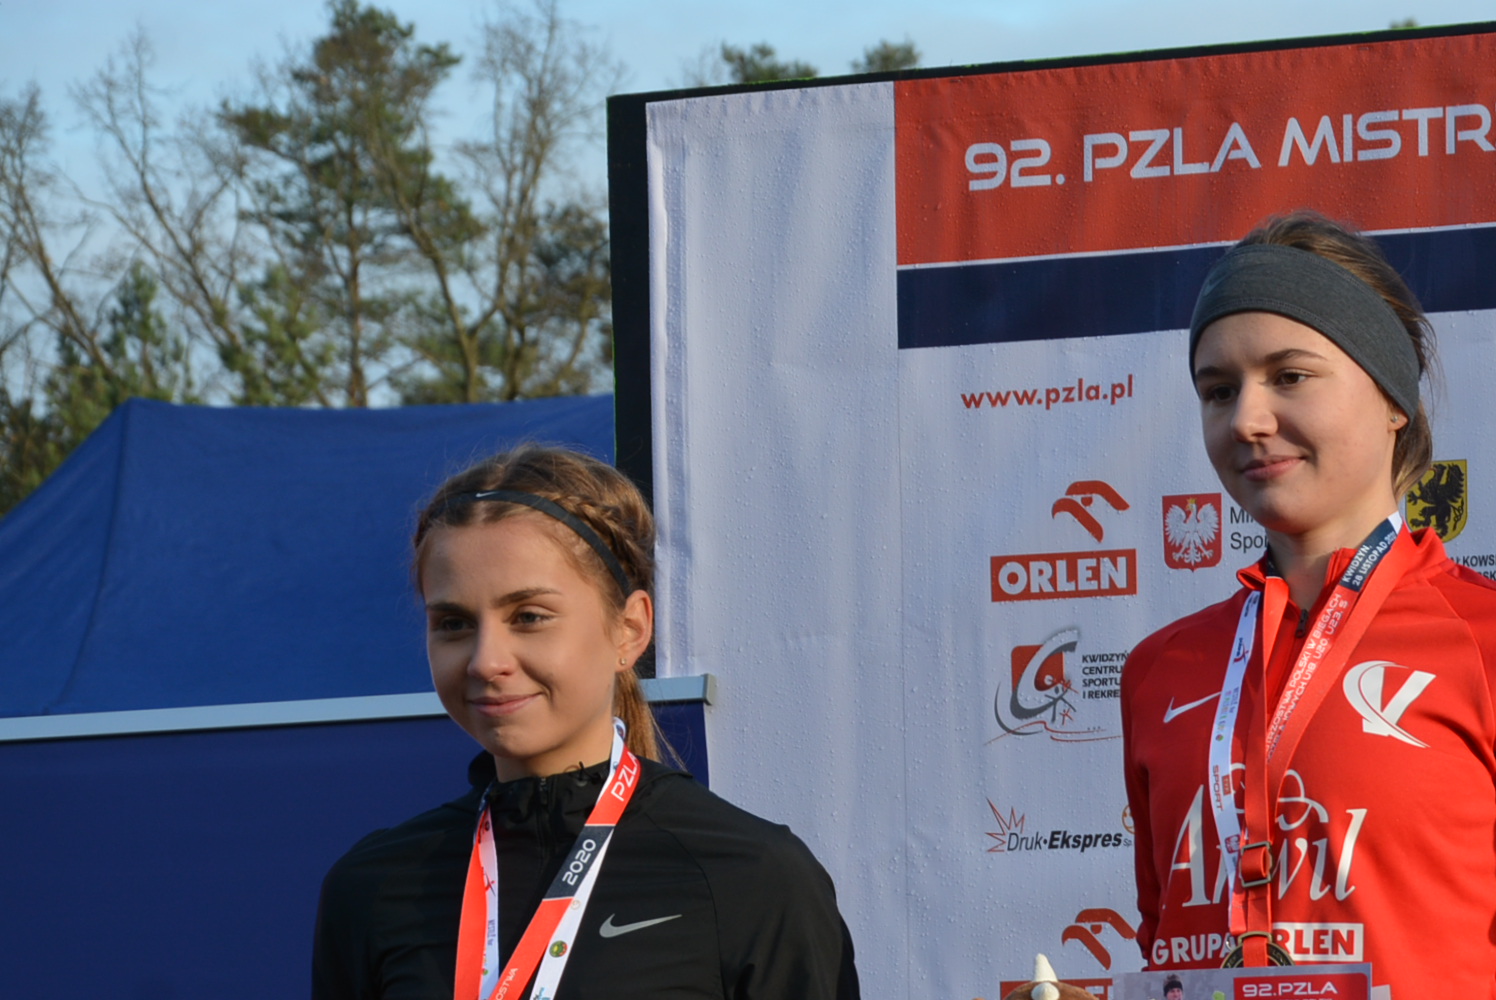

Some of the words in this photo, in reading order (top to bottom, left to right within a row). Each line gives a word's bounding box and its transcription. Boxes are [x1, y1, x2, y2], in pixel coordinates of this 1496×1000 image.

[964, 137, 1065, 192] 92.
[1083, 122, 1262, 184] PZLA
[960, 374, 1136, 411] www.pzla.pl
[999, 556, 1129, 596] ORLEN
[1353, 575, 1361, 586] 28
[1212, 765, 1223, 811] SPORT
[562, 838, 597, 886] 2020
